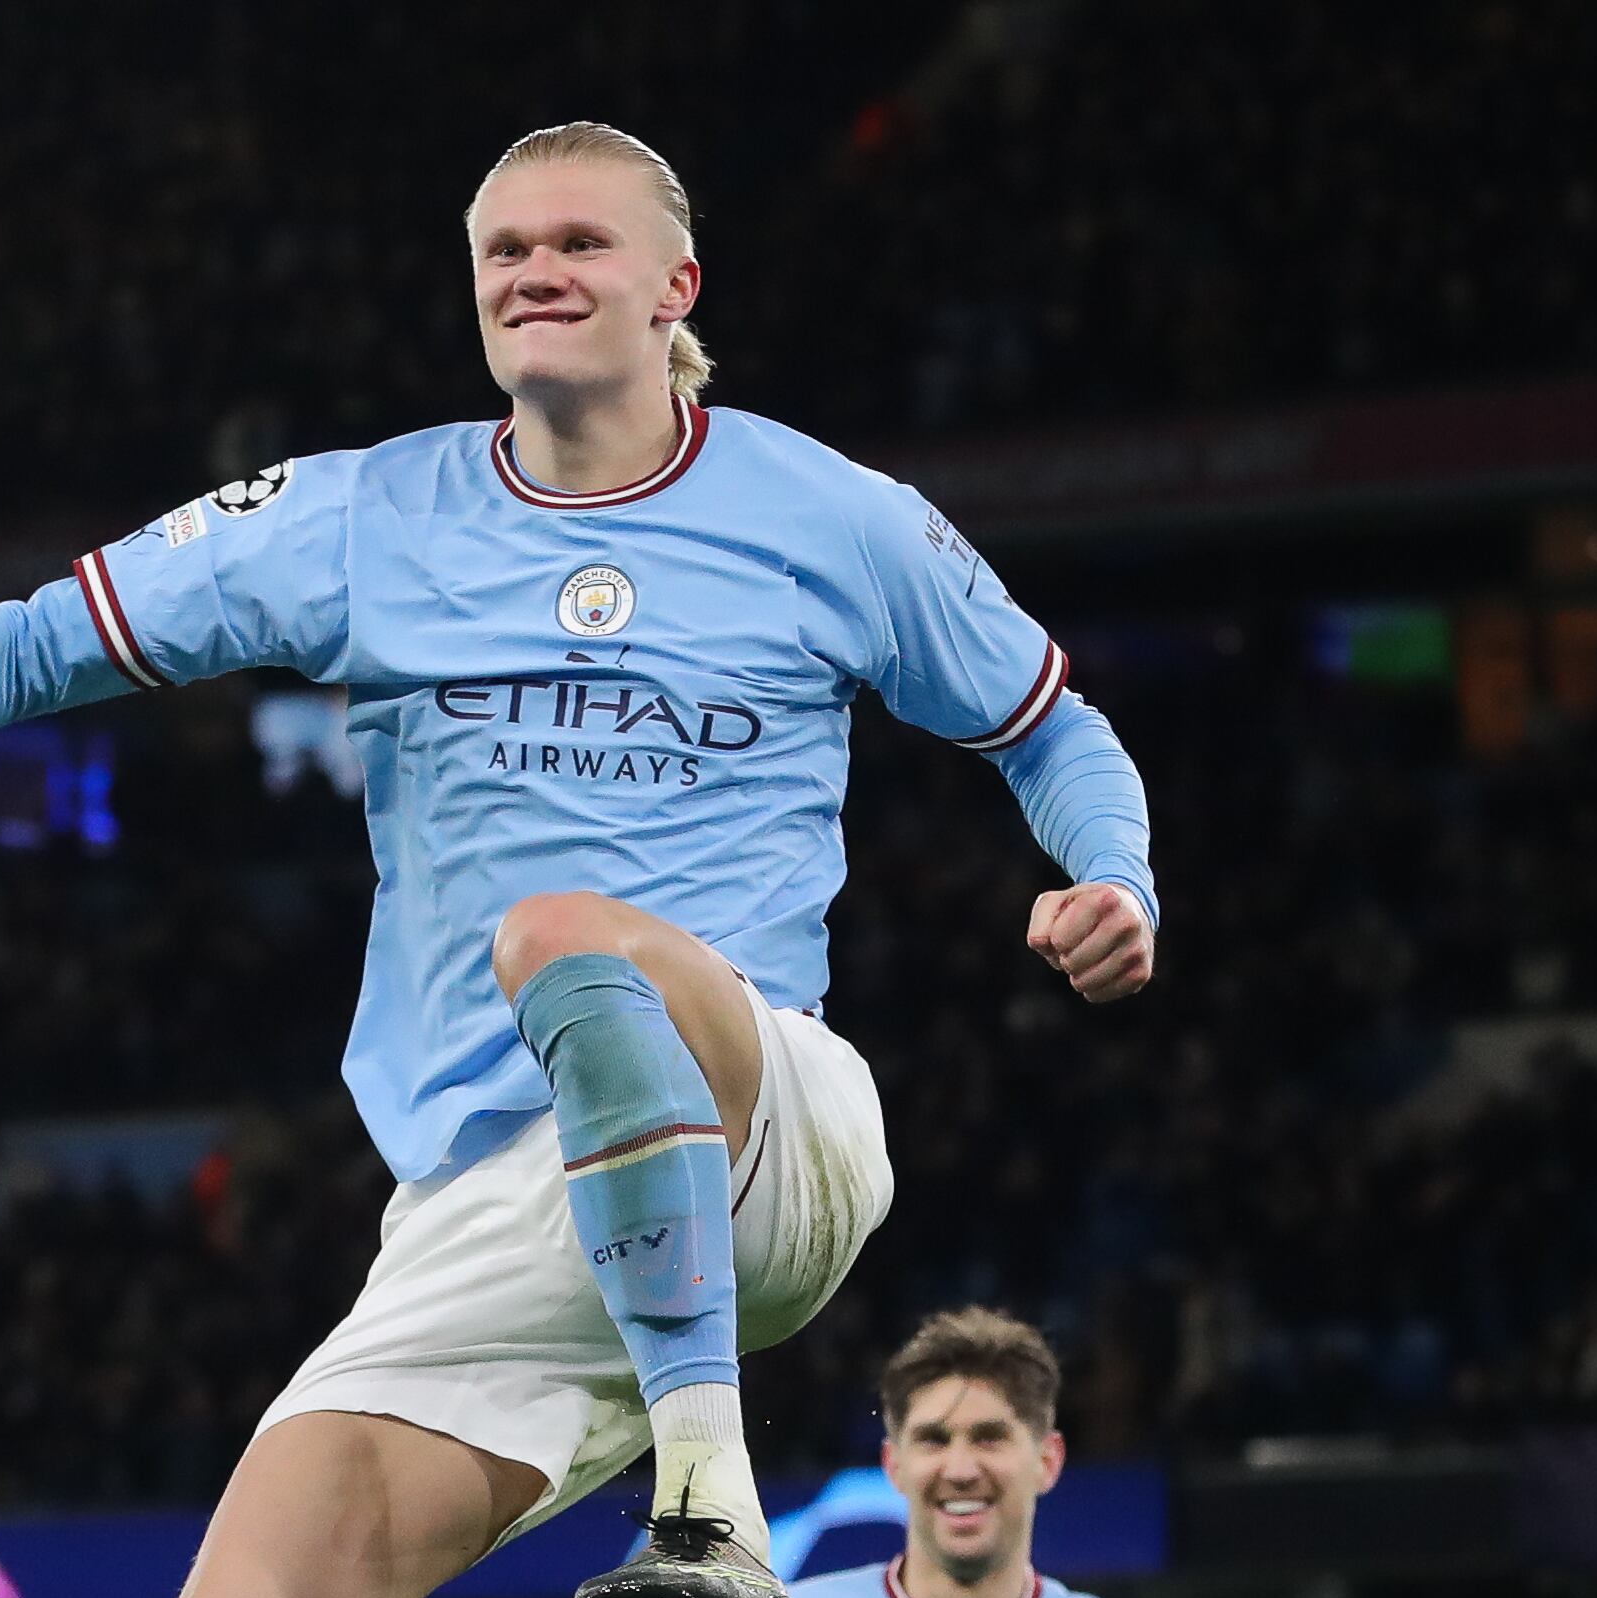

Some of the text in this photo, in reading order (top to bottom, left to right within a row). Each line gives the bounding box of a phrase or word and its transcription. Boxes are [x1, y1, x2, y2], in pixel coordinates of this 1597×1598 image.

[565, 570, 628, 598] MANCHESTER
[583, 627, 608, 635] CITY
[435, 677, 763, 751] ETIHAD
[488, 742, 700, 787] AIRWAYS
[593, 1226, 669, 1266] CITY
